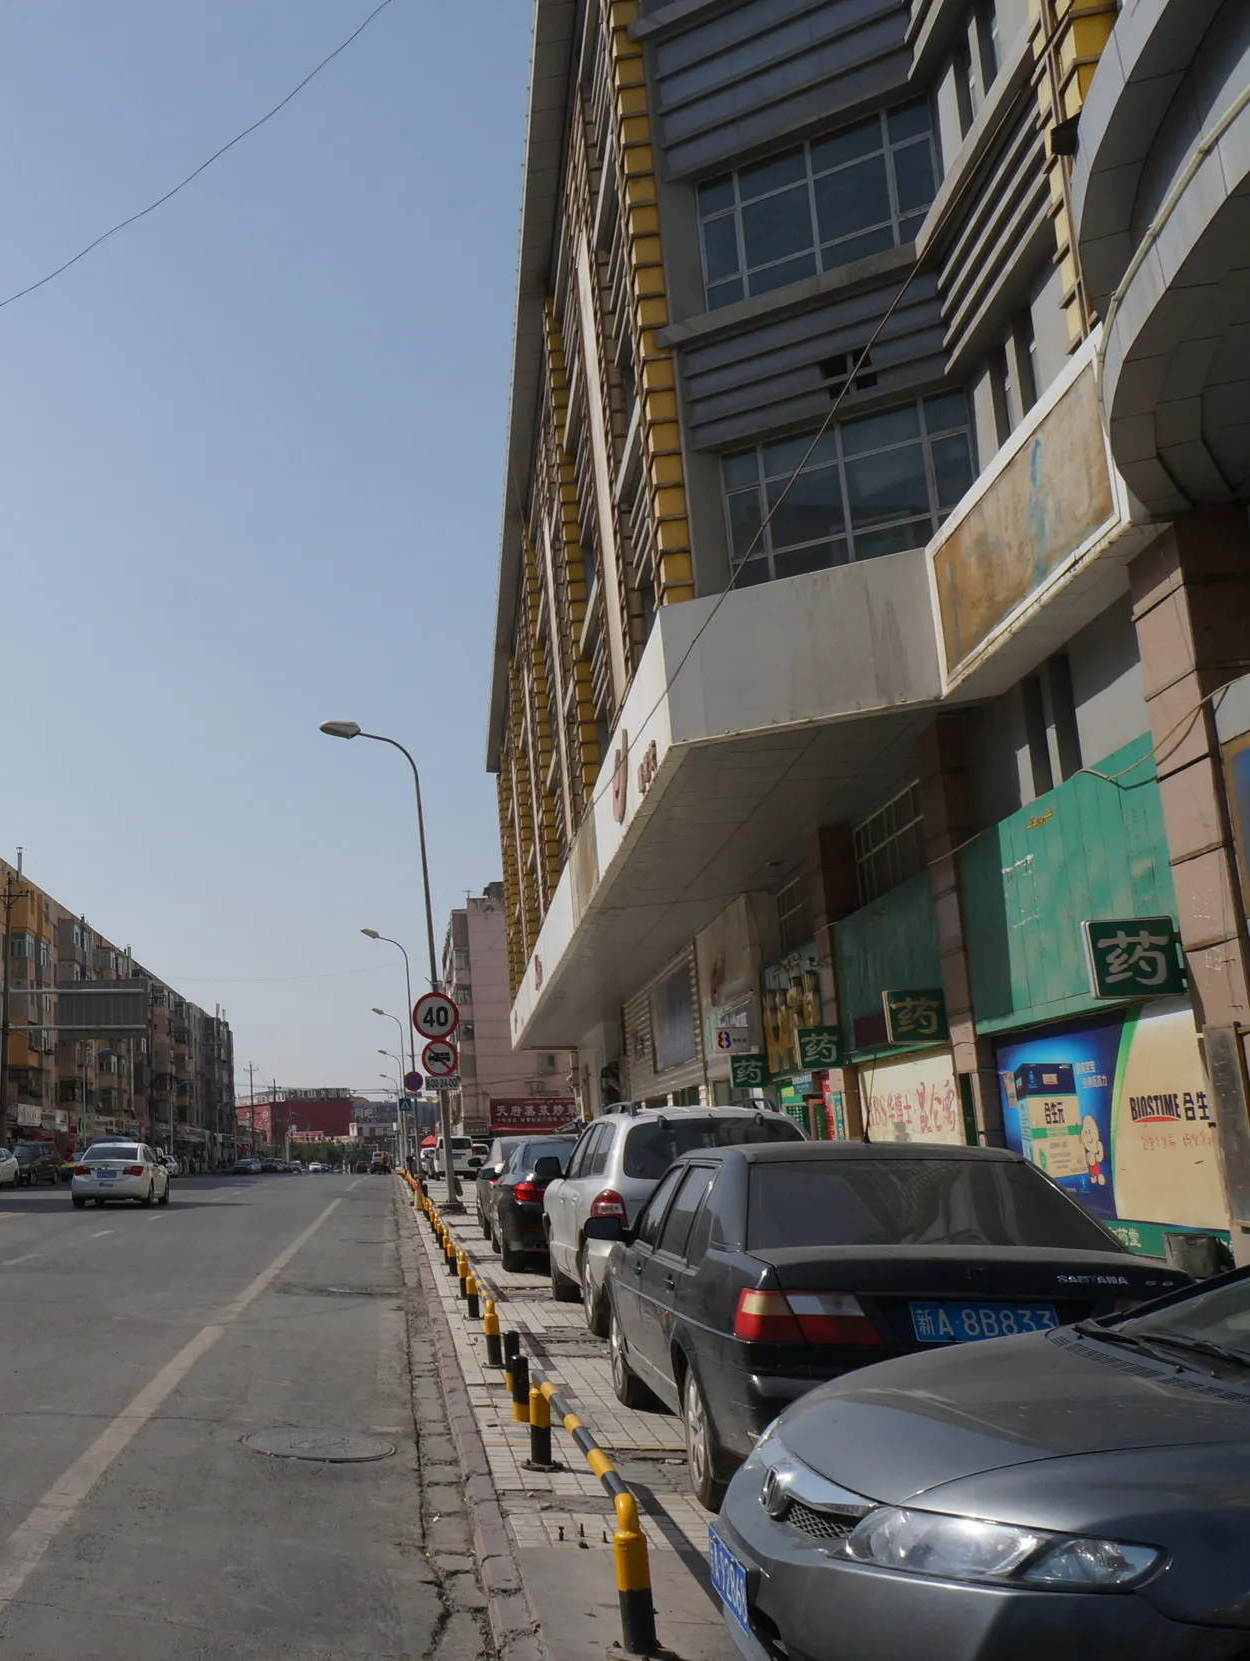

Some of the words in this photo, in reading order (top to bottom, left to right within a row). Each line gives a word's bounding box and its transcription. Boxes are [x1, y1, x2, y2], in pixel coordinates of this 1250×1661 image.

[1097, 930, 1170, 986] 药
[423, 1006, 449, 1028] 40
[890, 997, 939, 1035] 药
[801, 1032, 838, 1064] 药
[733, 1059, 764, 1085] 药
[1044, 1101, 1066, 1125] 合生元
[1129, 1093, 1181, 1121] BIOSTIME
[1183, 1091, 1211, 1121] 合生
